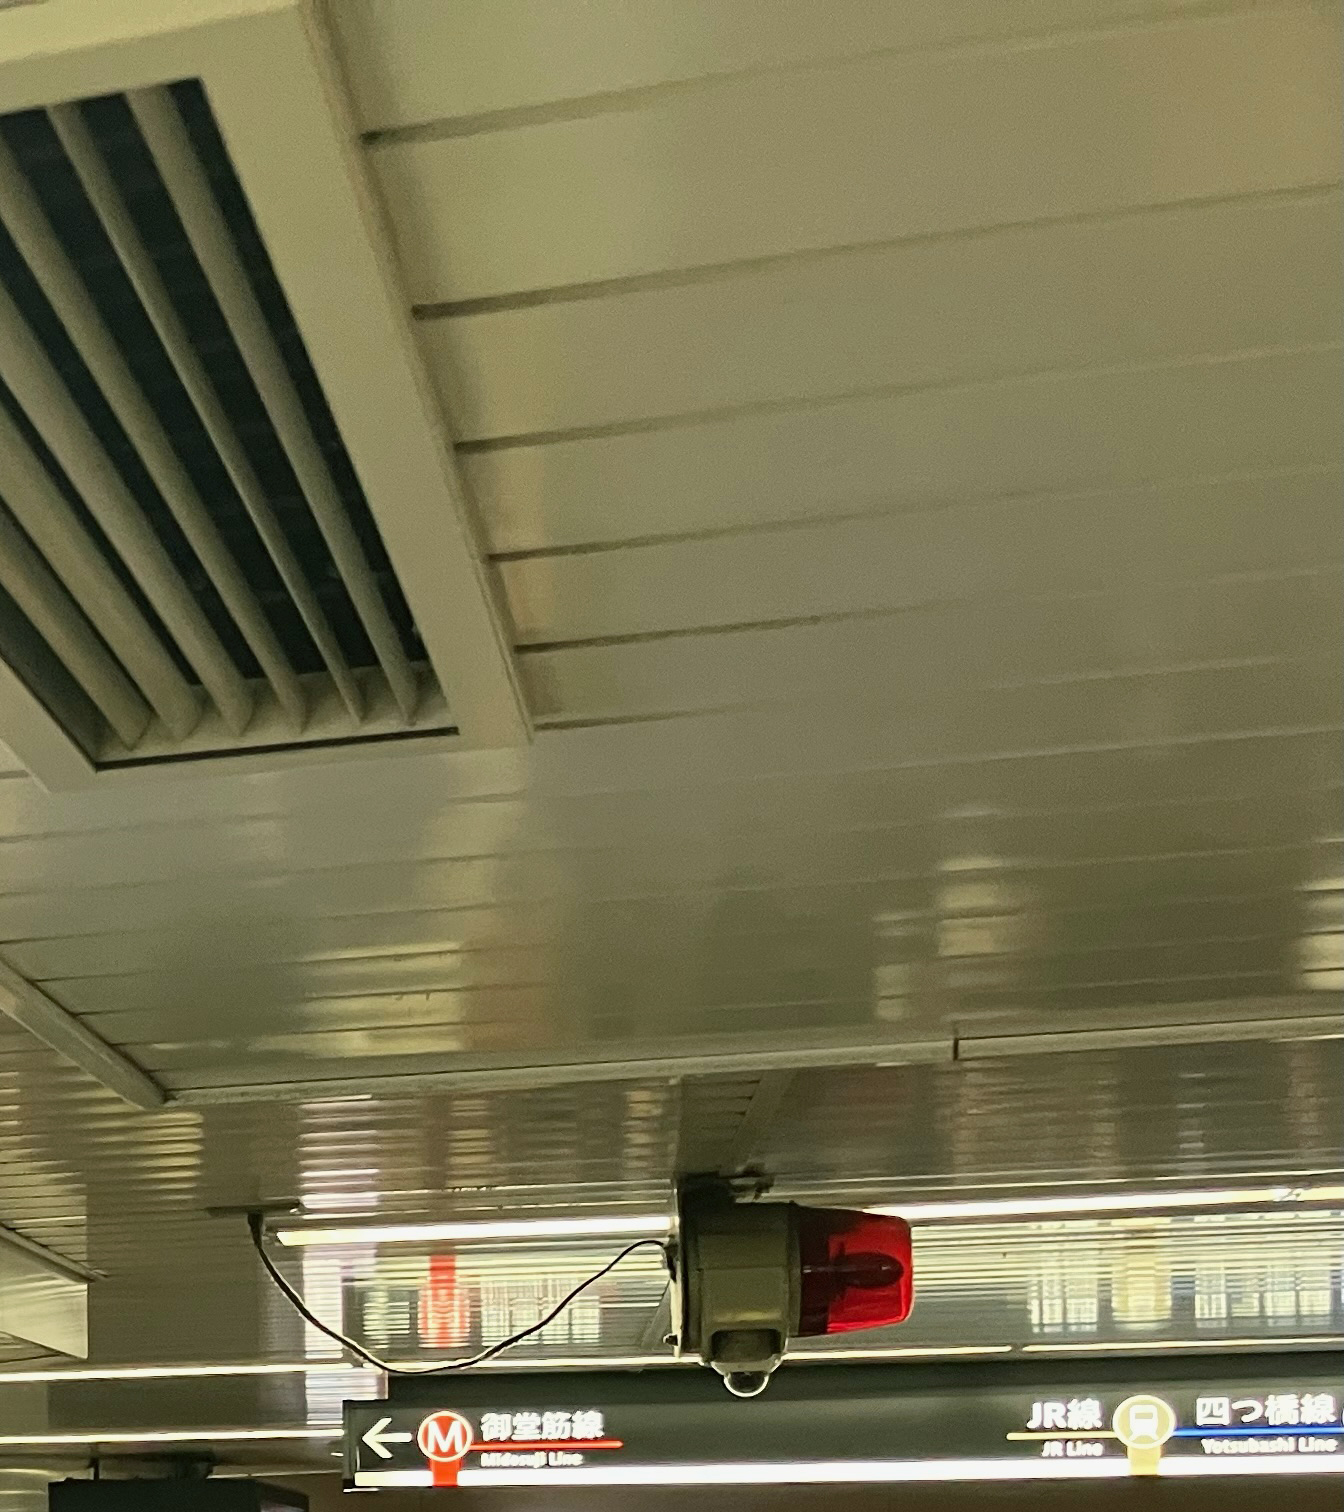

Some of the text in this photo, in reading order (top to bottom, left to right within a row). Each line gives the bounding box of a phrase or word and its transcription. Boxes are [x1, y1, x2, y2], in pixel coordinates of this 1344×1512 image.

[1027, 1398, 1103, 1429] JR線
[1196, 1393, 1337, 1426] 四つ橋線
[427, 1421, 462, 1453] M
[481, 1410, 604, 1441] 御堂筋線
[549, 1453, 583, 1467] Line
[1041, 1440, 1103, 1457] JR Line
[1201, 1437, 1338, 1454] Yotsubashi Line
